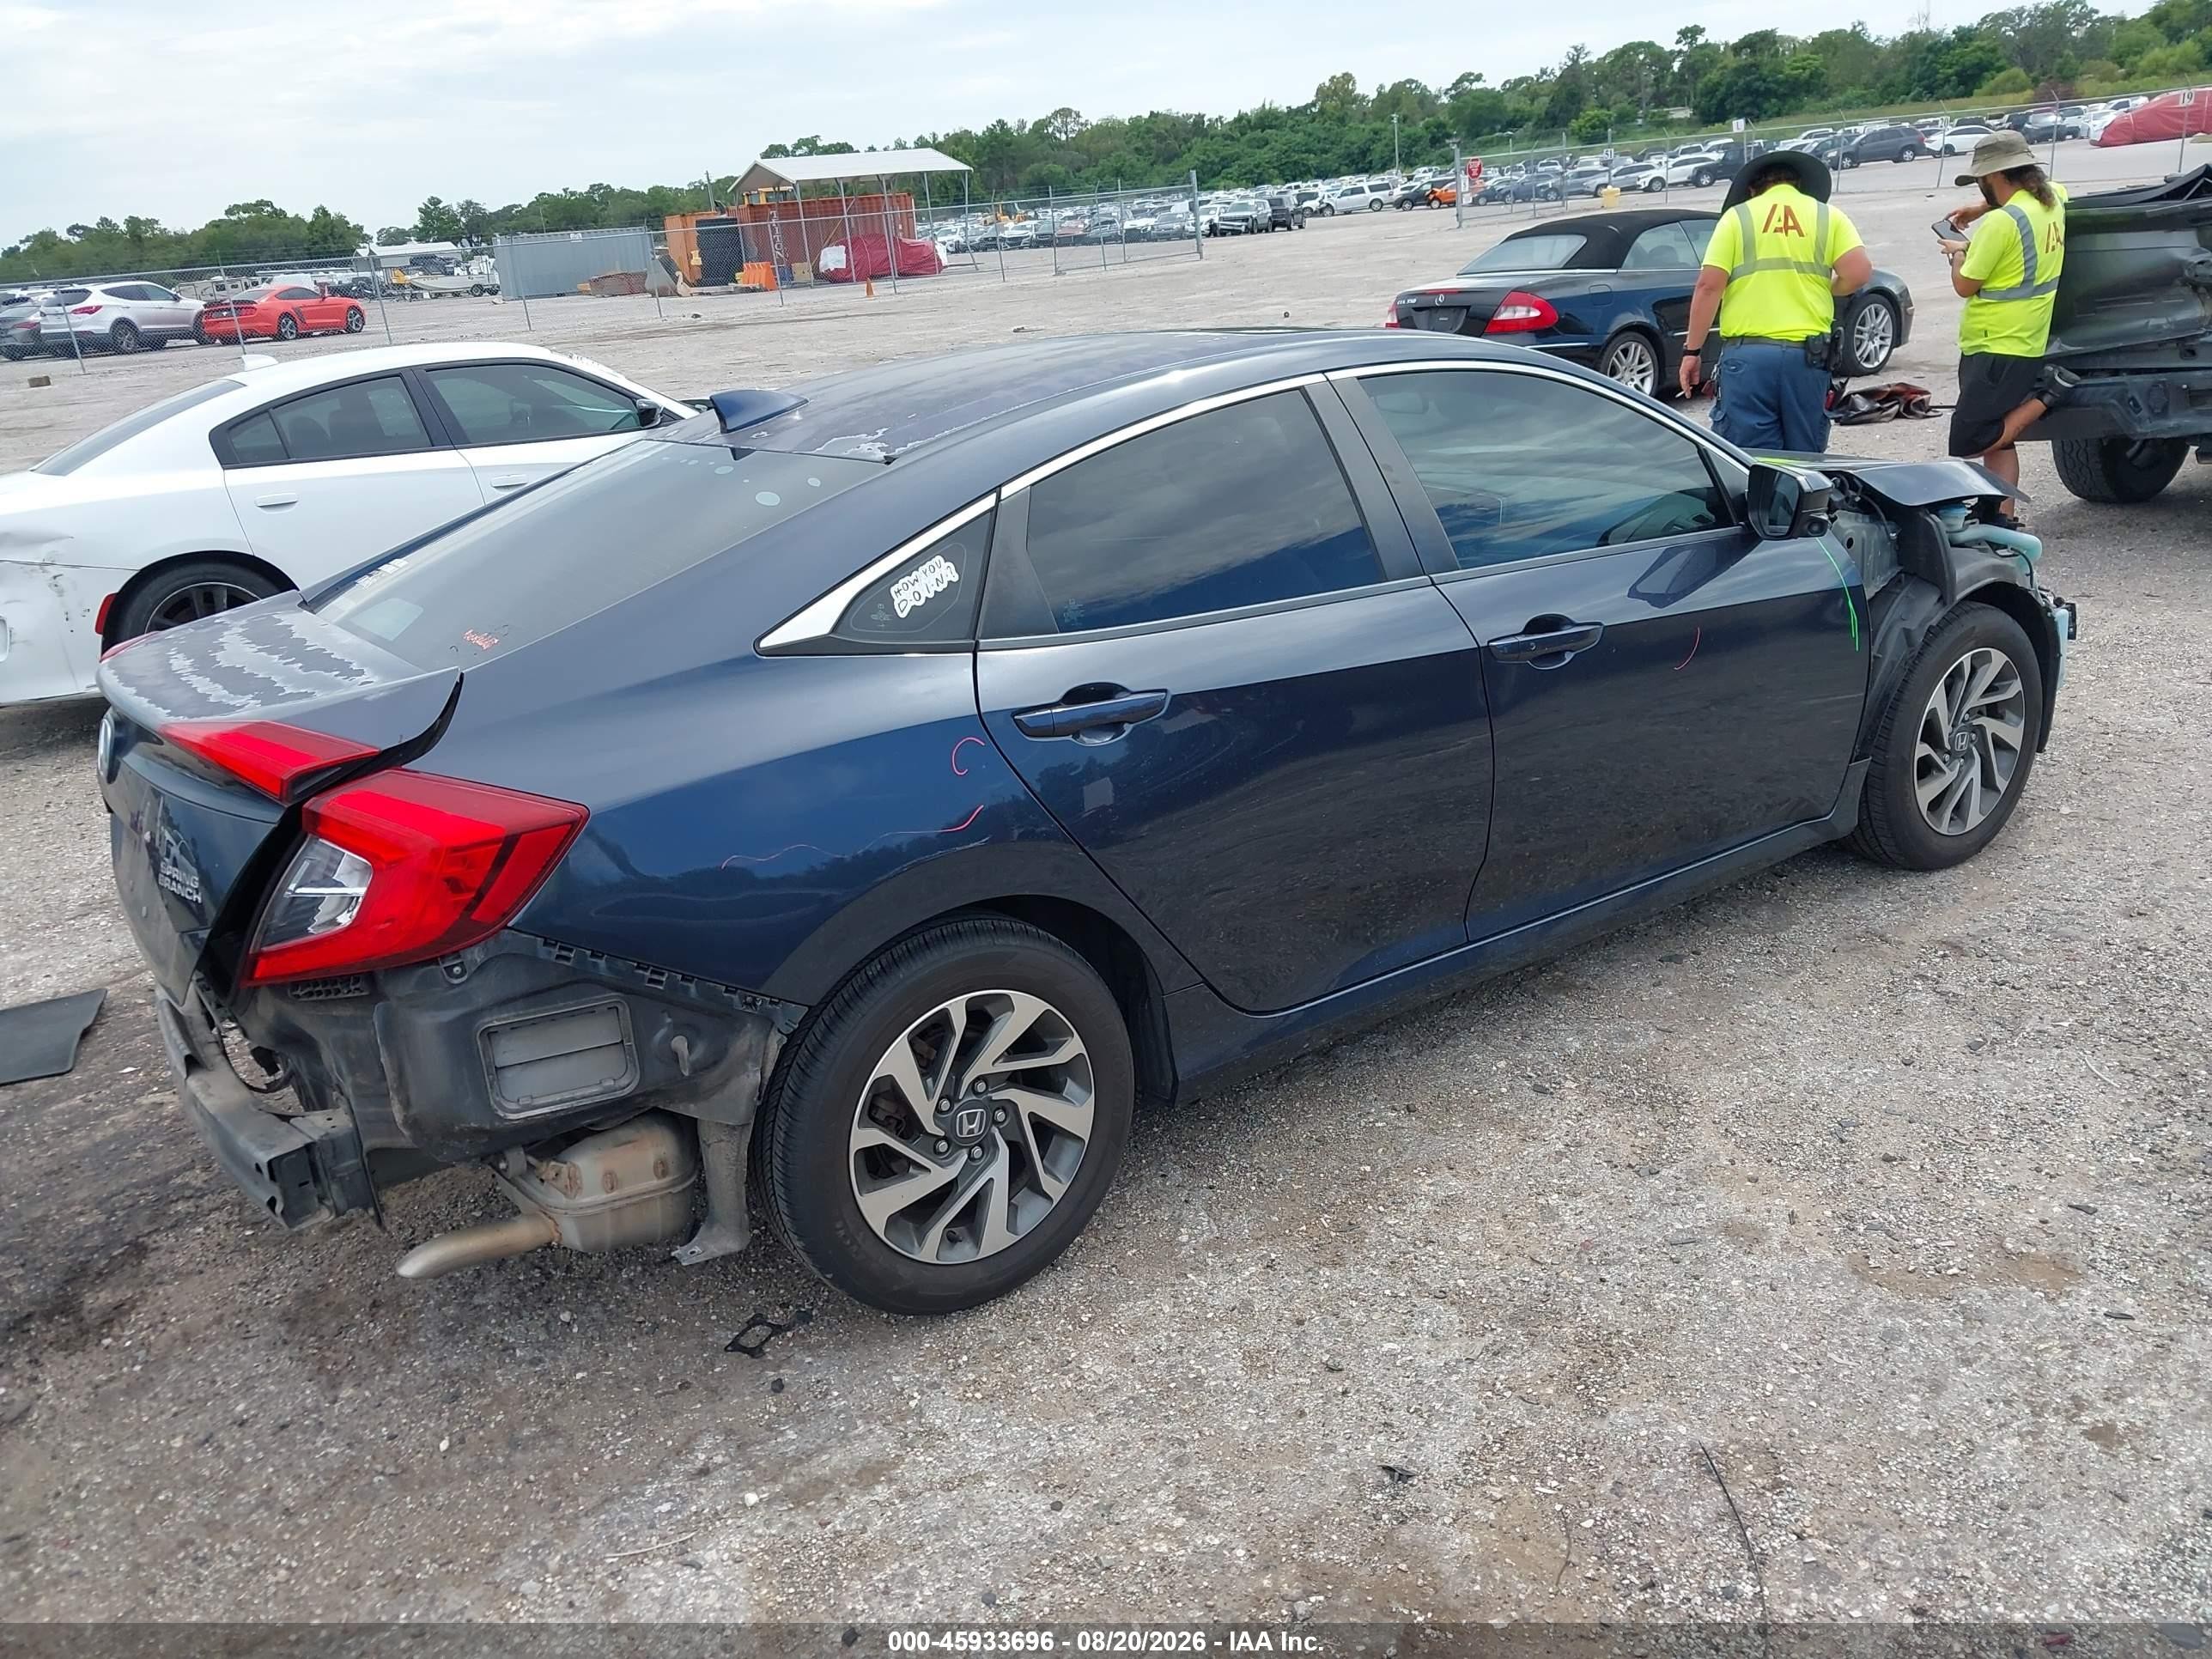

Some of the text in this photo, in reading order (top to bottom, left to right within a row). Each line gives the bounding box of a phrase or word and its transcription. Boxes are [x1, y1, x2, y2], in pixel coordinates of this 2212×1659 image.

[2182, 91, 2193, 104] 19
[1605, 149, 1613, 159] 51
[894, 558, 942, 599] HOW YOU
[158, 873, 203, 904] BRANCH
[160, 860, 200, 889] SPRING
